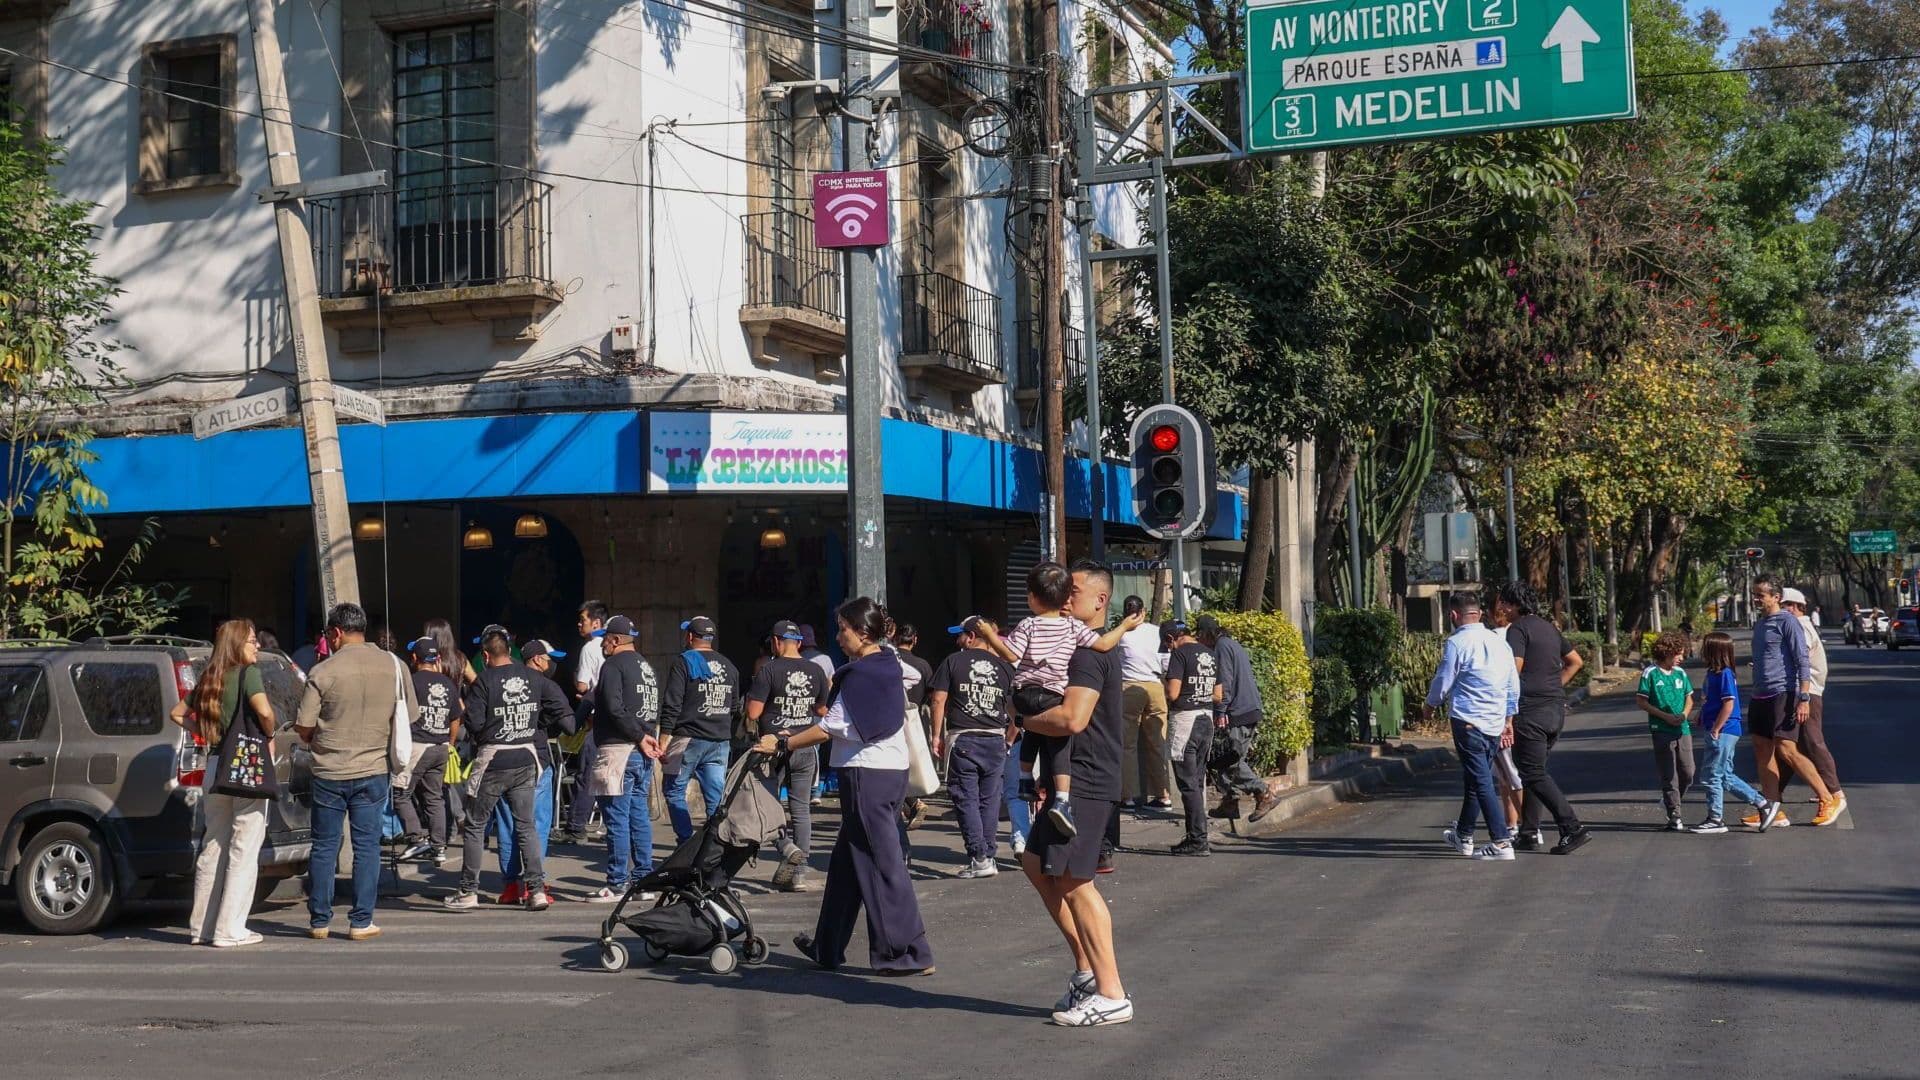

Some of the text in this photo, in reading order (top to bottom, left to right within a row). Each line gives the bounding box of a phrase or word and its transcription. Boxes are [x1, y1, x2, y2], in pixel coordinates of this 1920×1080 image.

[1483, 0, 1502, 18] 2
[1485, 17, 1501, 26] PTE
[1271, 0, 1448, 51] AV MONTERREY
[1293, 44, 1463, 84] PARQUE ESPAÑA
[1285, 105, 1300, 129] 3
[1336, 77, 1521, 129] MEDELLIN
[1287, 128, 1302, 137] PTE
[818, 178, 843, 187] CDMX
[209, 397, 280, 430] ATLIXCO
[665, 447, 708, 484] LA
